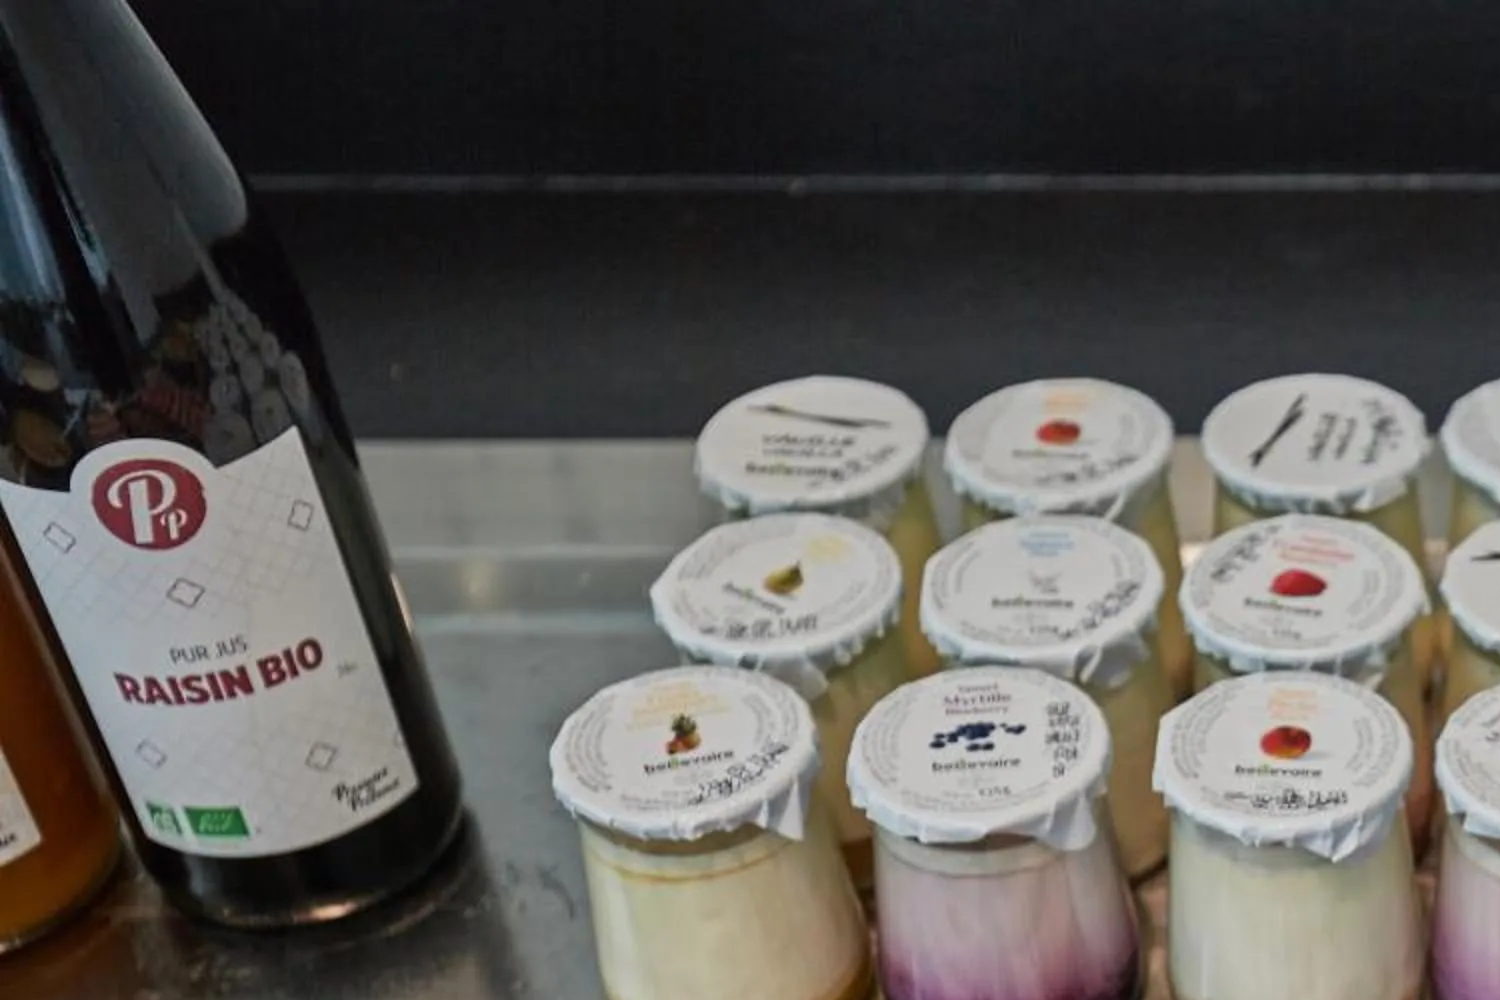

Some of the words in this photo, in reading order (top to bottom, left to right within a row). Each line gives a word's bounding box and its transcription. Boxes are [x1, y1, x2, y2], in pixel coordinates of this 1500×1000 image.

[114, 664, 254, 706] RAISIN
[262, 637, 324, 689] BIO
[170, 646, 211, 664] PUR
[215, 634, 249, 657] JUS
